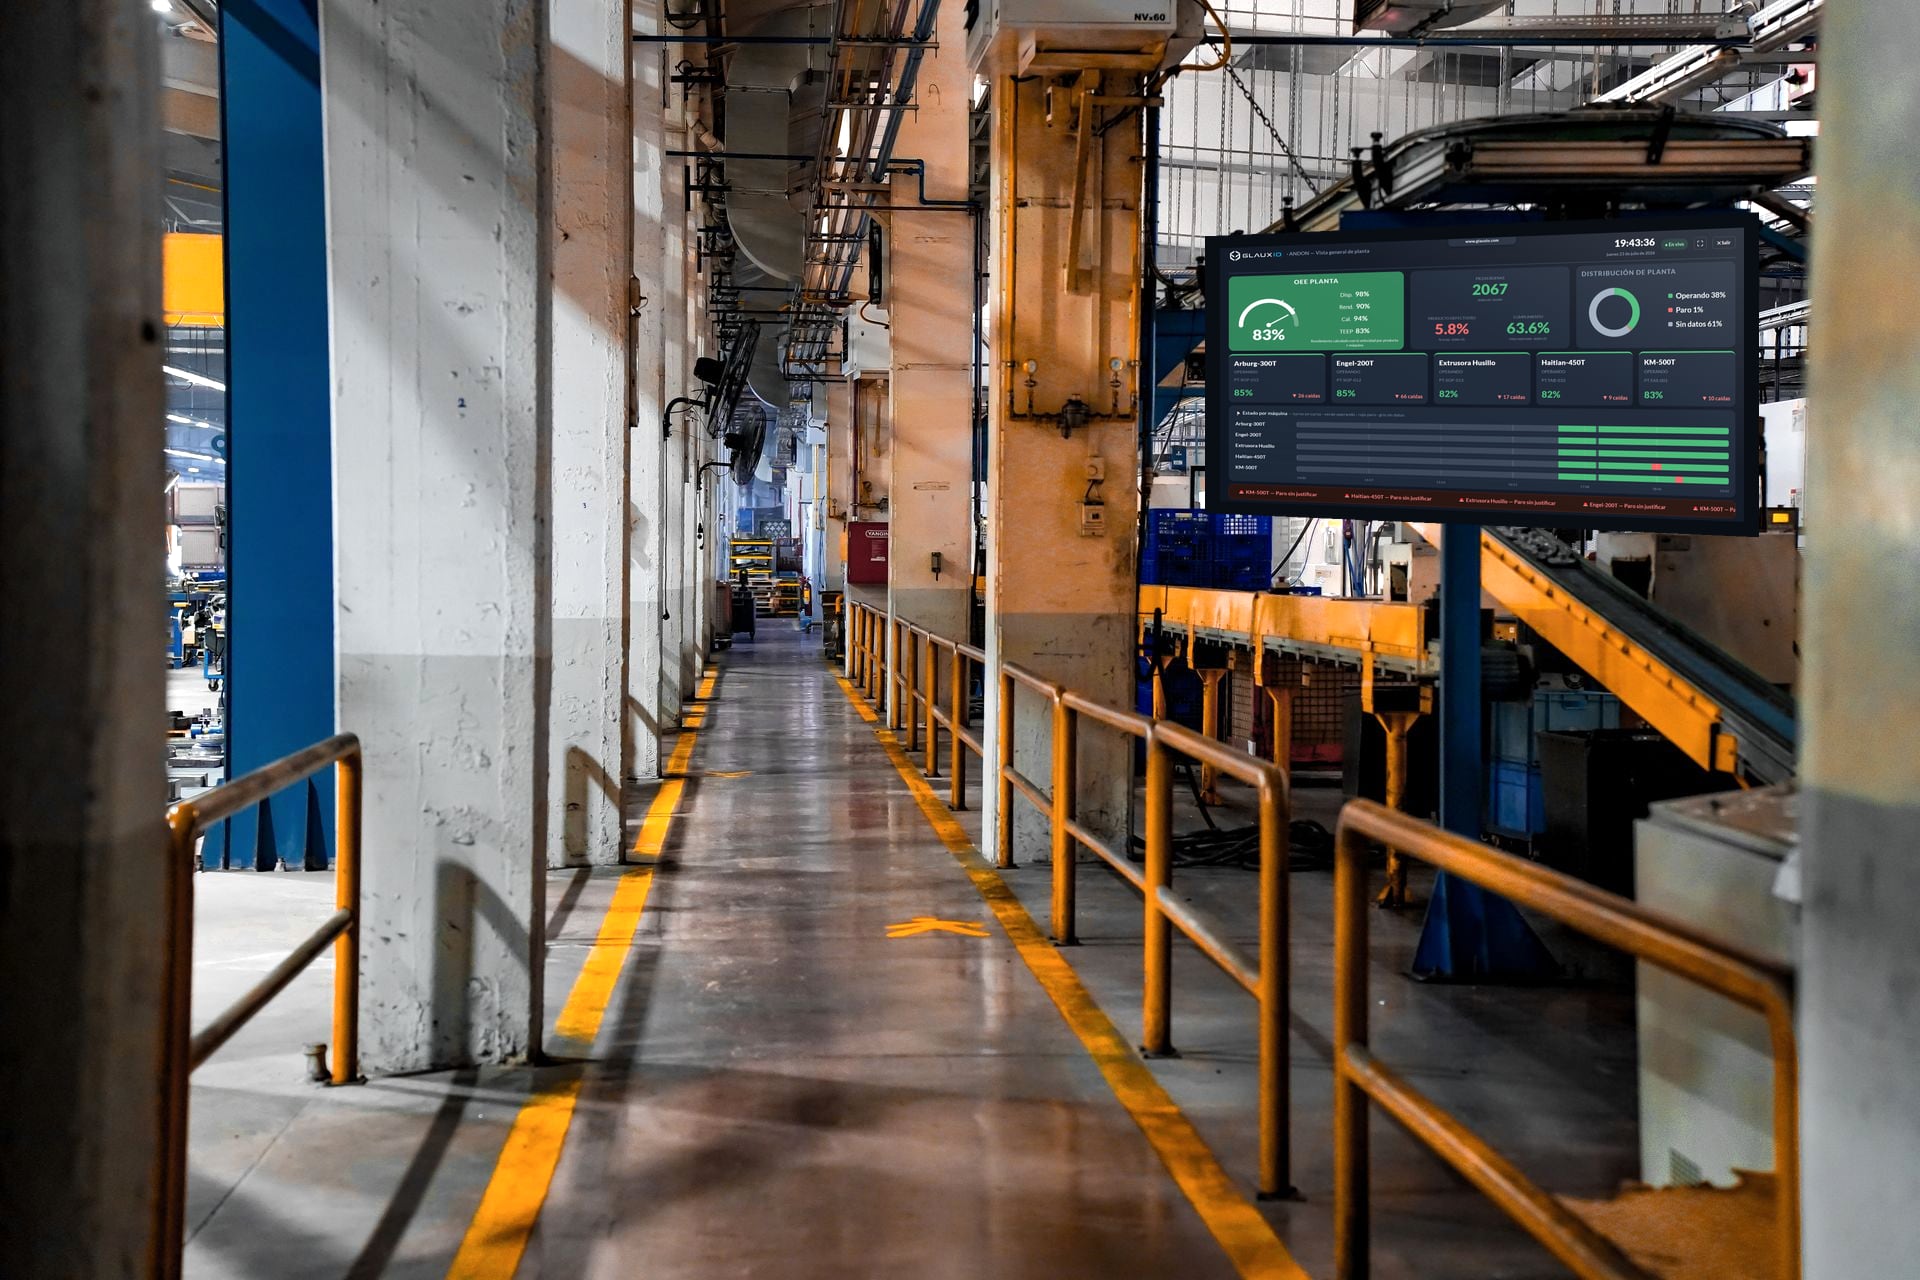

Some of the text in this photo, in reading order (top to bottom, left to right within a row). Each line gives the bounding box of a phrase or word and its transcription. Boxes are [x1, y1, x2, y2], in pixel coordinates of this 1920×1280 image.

[1134, 13, 1166, 21] NVx60
[1614, 238, 1655, 247] 19:43:36
[1581, 268, 1634, 277] DISTRIBUCIÓN
[1472, 284, 1508, 295] 2067
[1676, 292, 1710, 301] Operando
[1435, 323, 1469, 335] 5.8%
[1507, 322, 1550, 334] 63.6%
[1252, 329, 1285, 341] 83%
[1644, 391, 1663, 399] 83%
